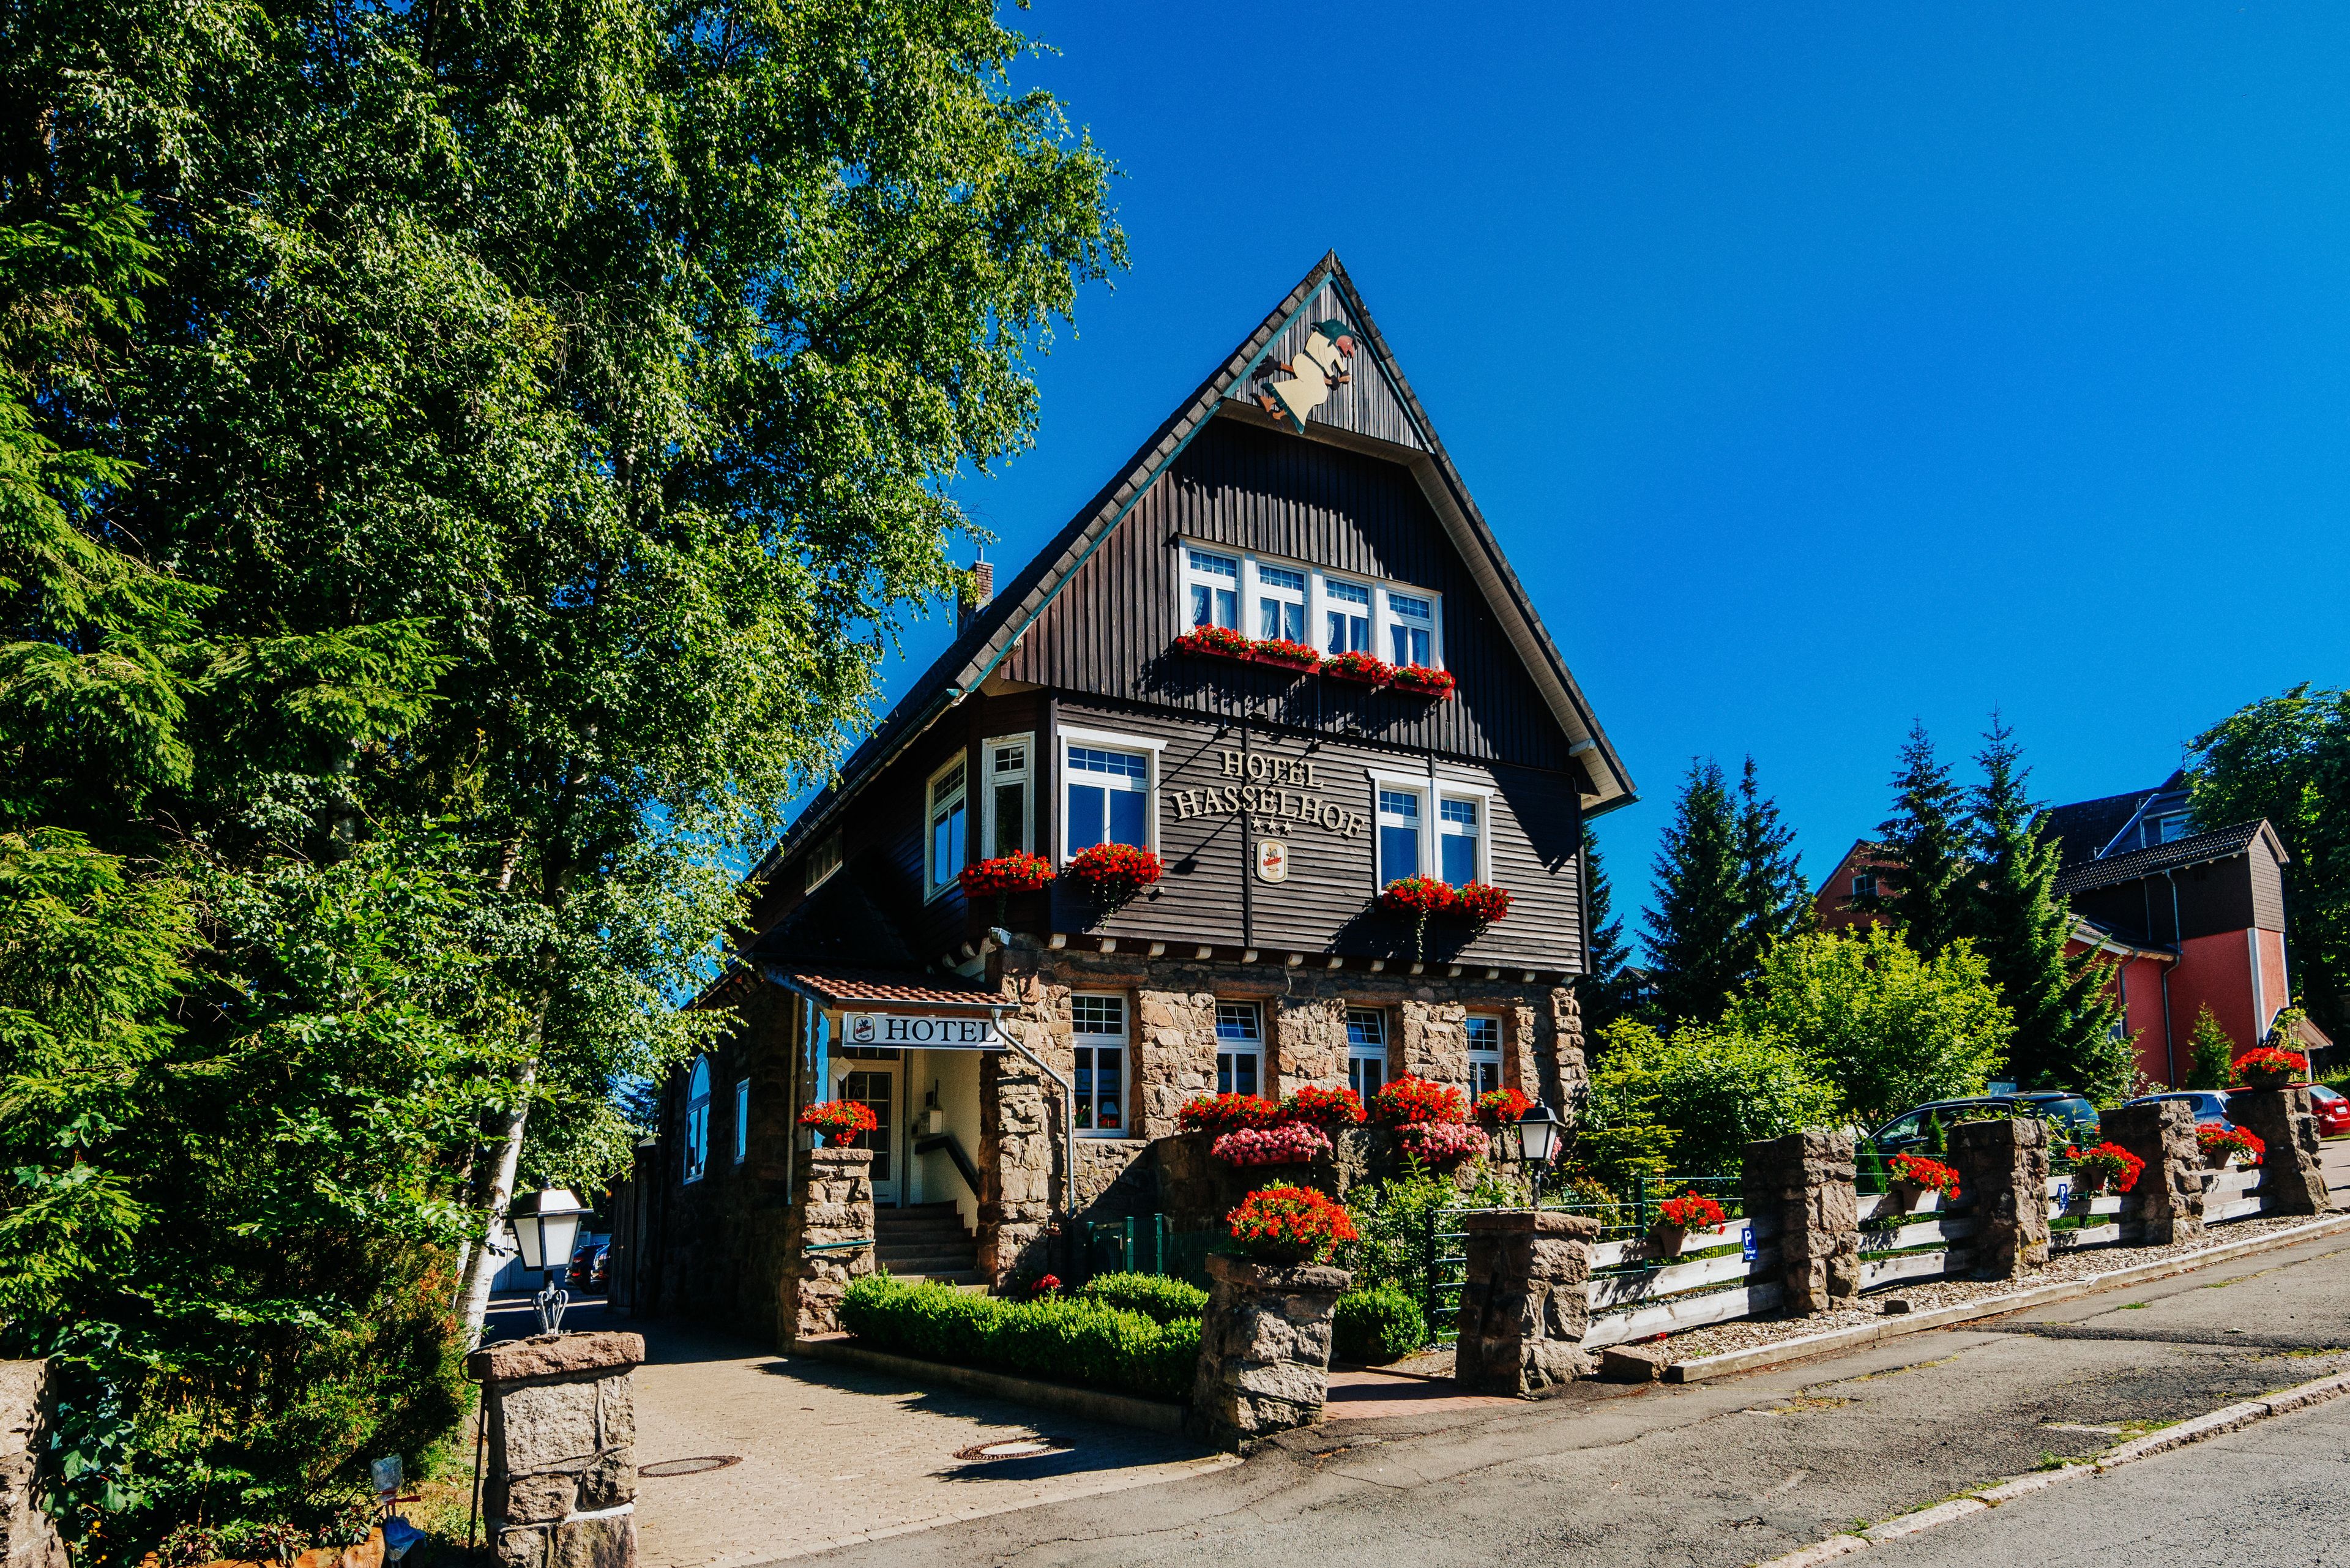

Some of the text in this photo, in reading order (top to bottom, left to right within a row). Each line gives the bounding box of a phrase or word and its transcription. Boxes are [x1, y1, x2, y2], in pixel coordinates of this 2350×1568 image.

[1223, 749, 1324, 788] HOTEL
[1173, 785, 1365, 838] HASSELHOF
[885, 1018, 998, 1042] HOTEL
[2061, 1185, 2066, 1199] P
[1744, 1230, 1751, 1246] P
